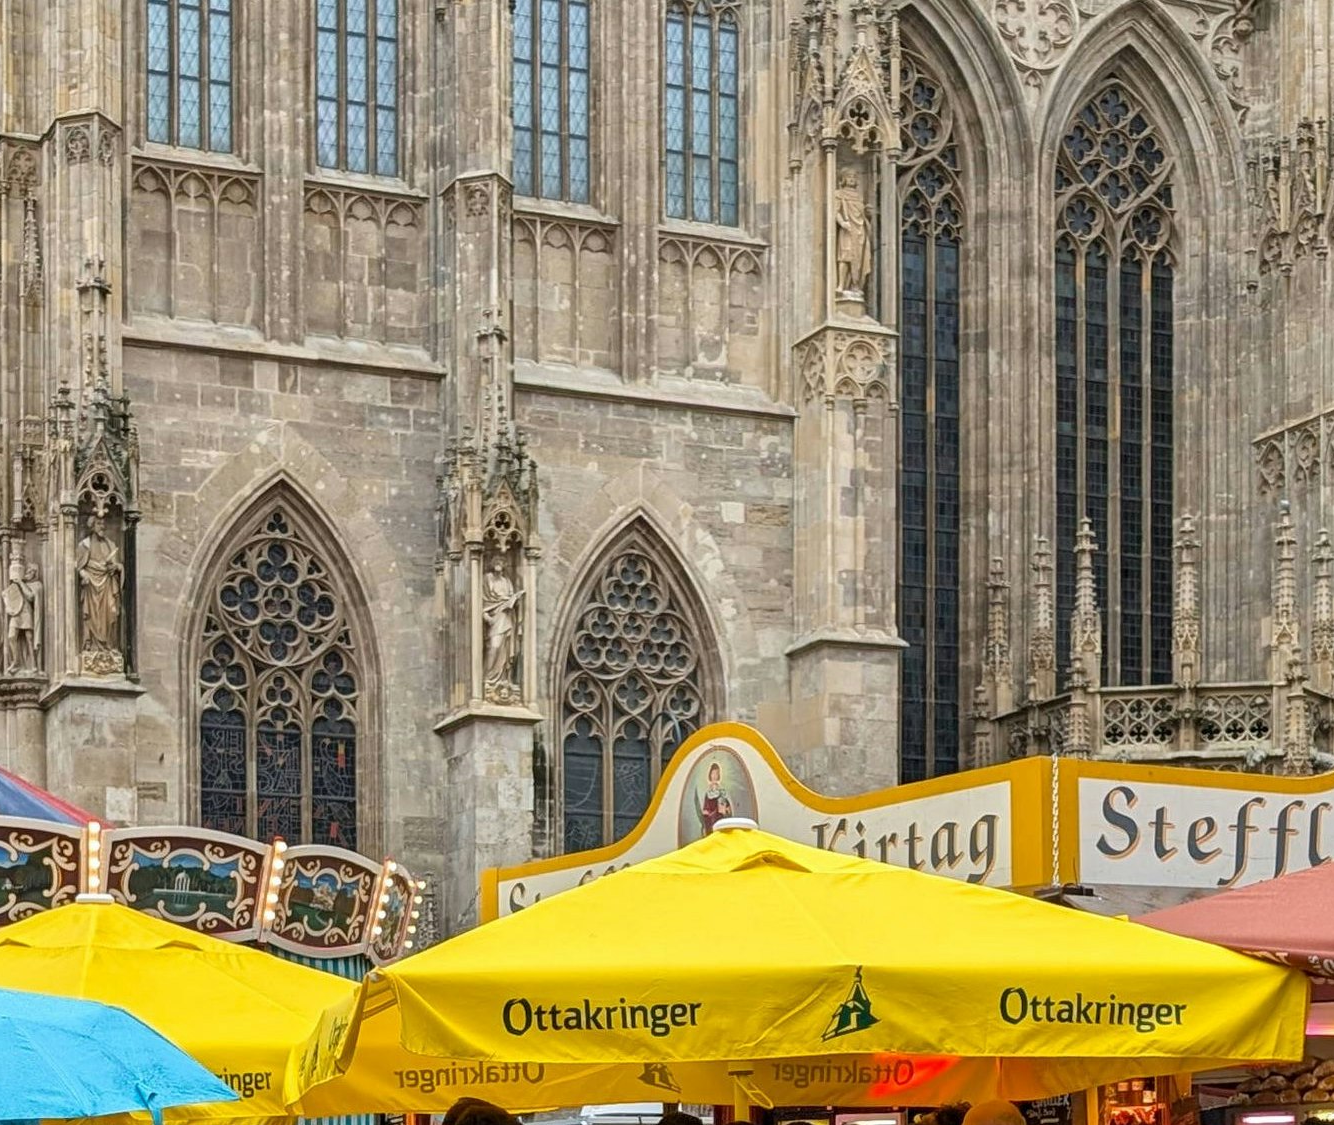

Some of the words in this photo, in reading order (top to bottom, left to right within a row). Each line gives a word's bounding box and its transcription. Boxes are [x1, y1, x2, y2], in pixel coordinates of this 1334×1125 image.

[1096, 785, 1333, 888] Steffl
[502, 998, 702, 1037] Ottakringer
[999, 986, 1187, 1033] Ottakringer
